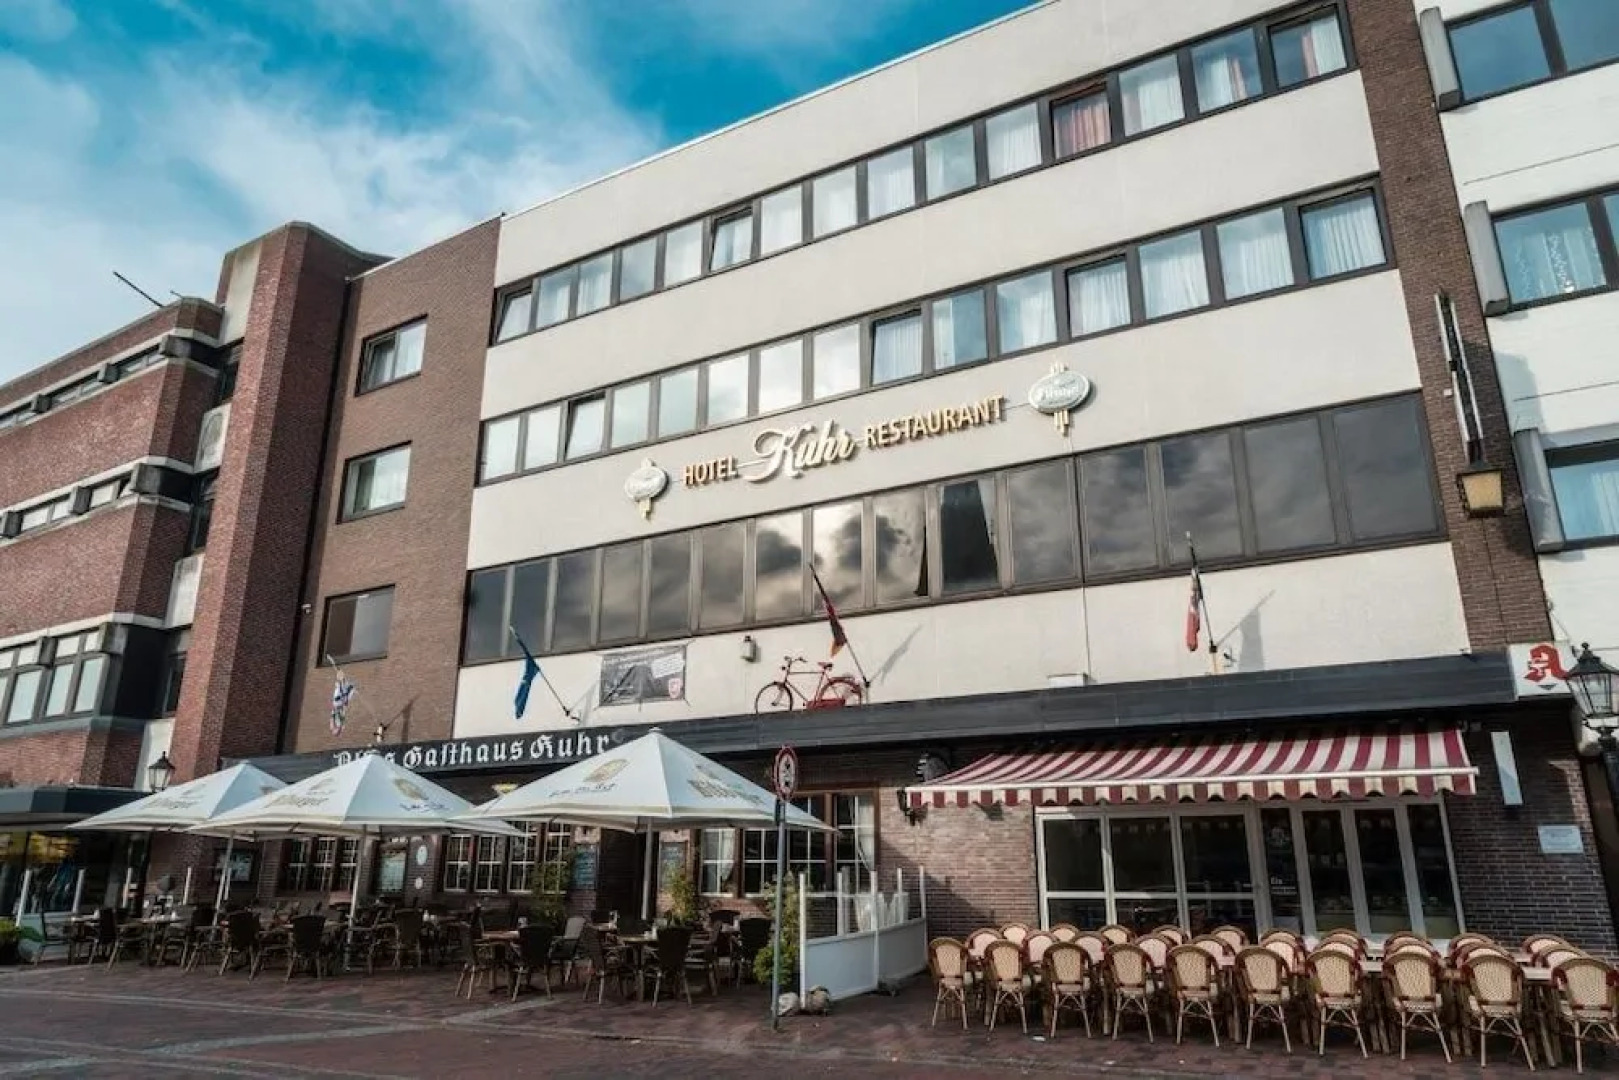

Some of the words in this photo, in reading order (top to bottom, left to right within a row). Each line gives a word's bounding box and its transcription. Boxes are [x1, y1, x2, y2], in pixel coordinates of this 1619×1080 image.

[682, 457, 738, 486] HOTEL
[743, 419, 857, 483] Kuhr
[865, 395, 1005, 448] RESTAURANT
[530, 731, 610, 759] Kuhr
